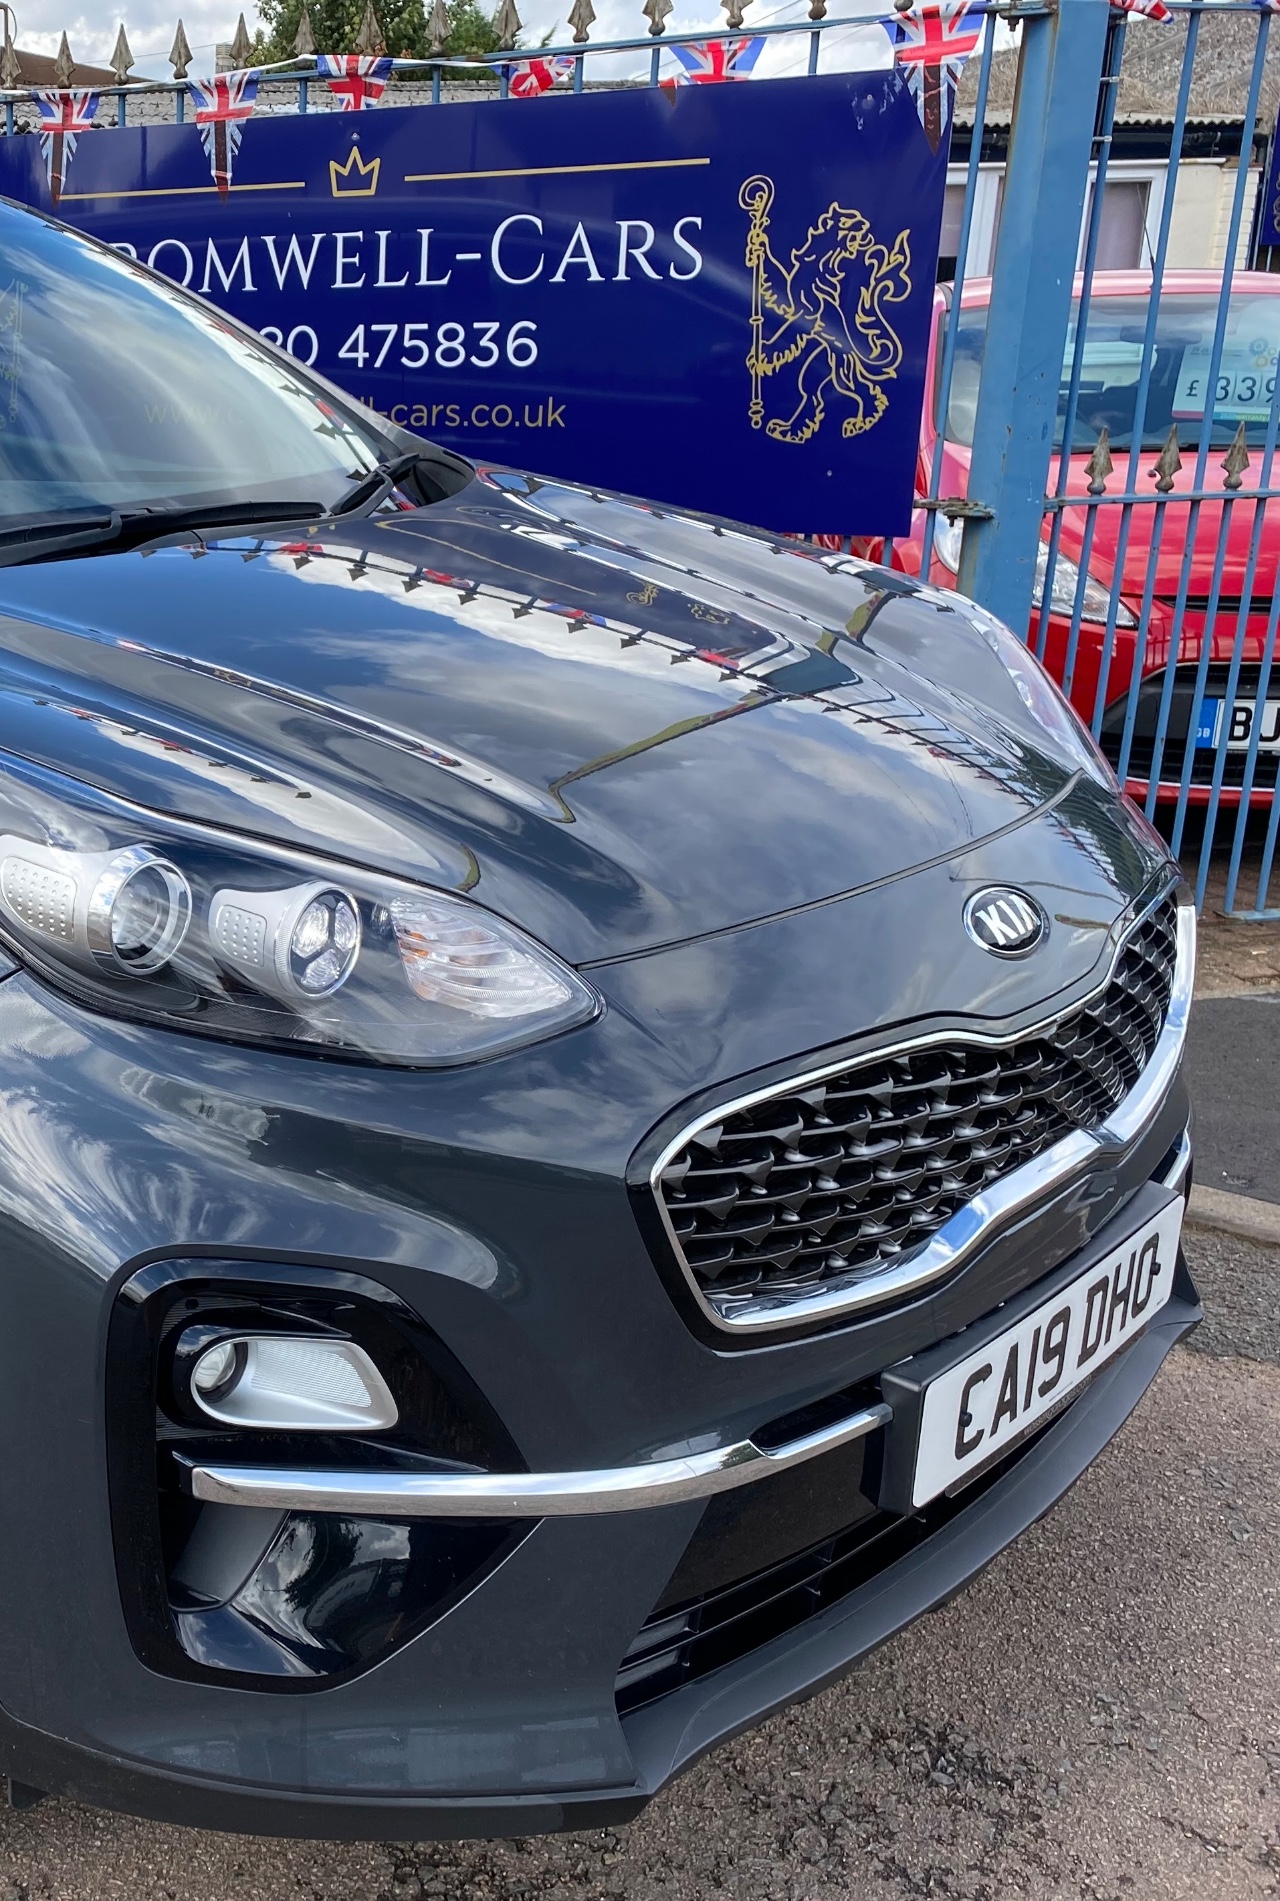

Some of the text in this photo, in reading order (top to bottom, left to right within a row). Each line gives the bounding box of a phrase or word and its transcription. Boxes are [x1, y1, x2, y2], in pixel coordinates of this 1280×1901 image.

[337, 320, 539, 368] 475836
[974, 893, 1042, 947] KIA
[954, 1231, 1161, 1461] CA19 DHO
